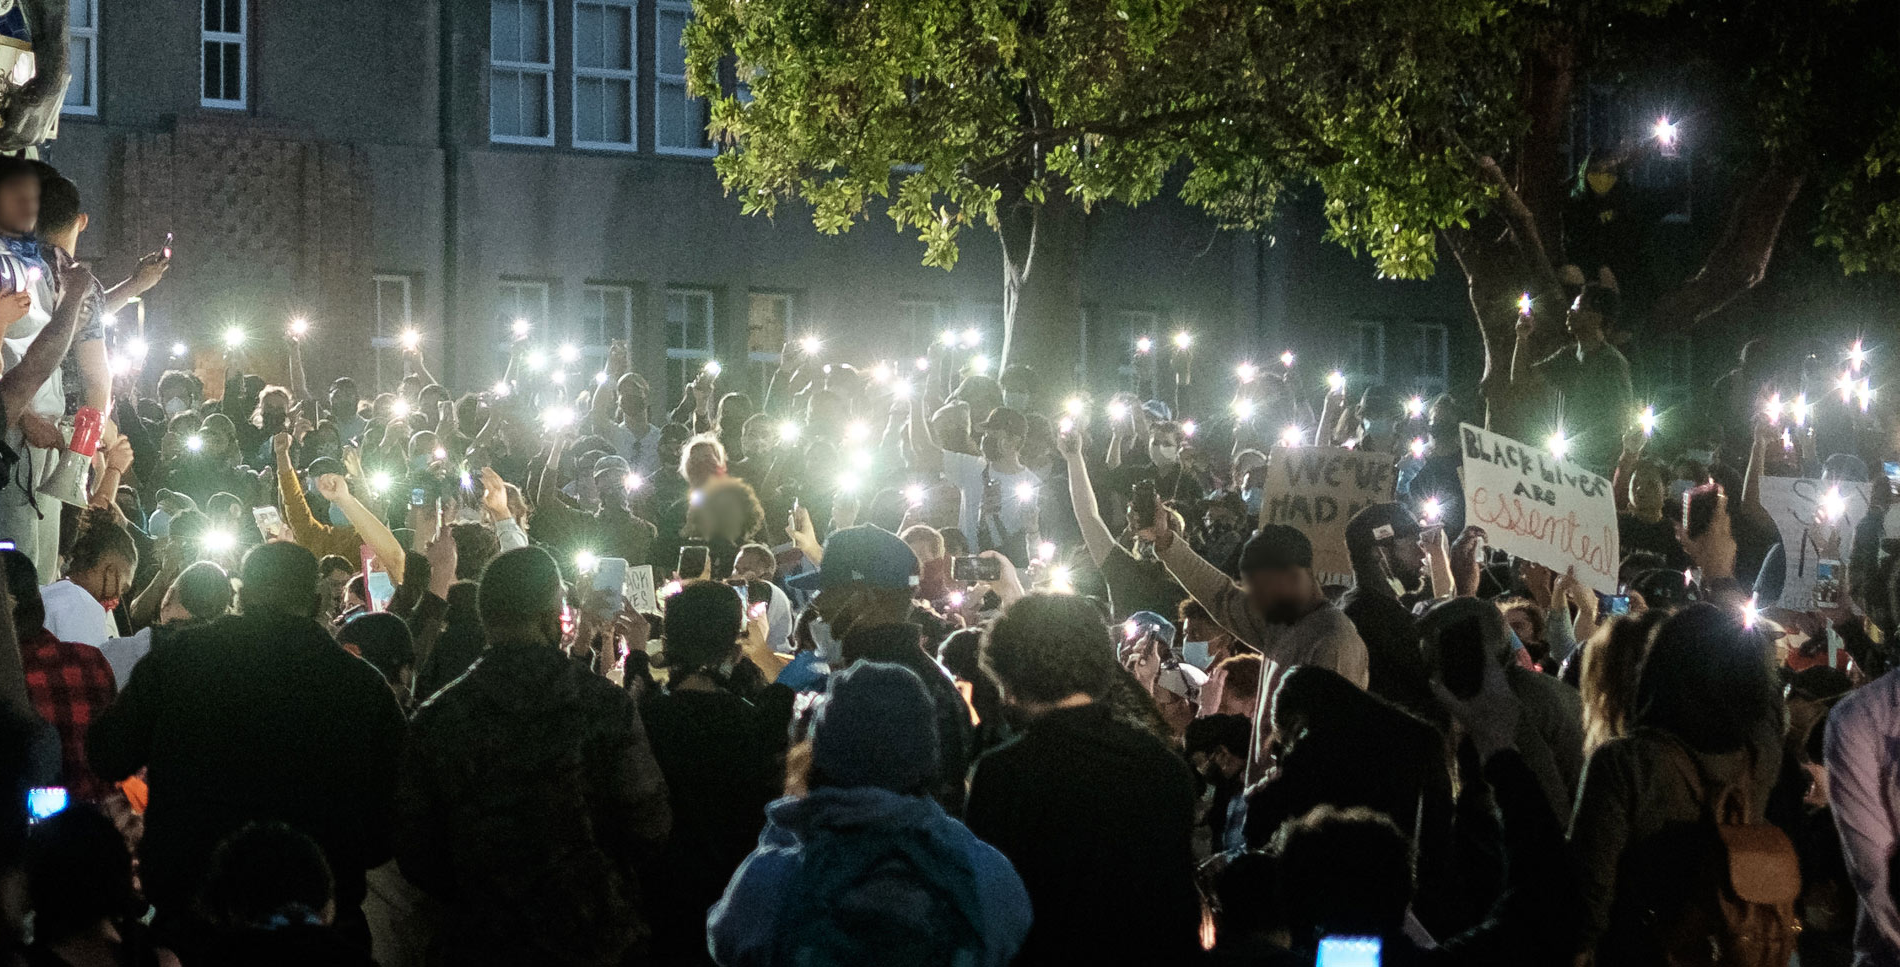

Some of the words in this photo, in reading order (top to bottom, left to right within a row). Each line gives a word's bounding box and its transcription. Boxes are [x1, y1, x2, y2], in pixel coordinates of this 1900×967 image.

[1463, 427, 1534, 475] BLACK
[1269, 494, 1338, 525] HAD
[626, 570, 649, 591] ACK
